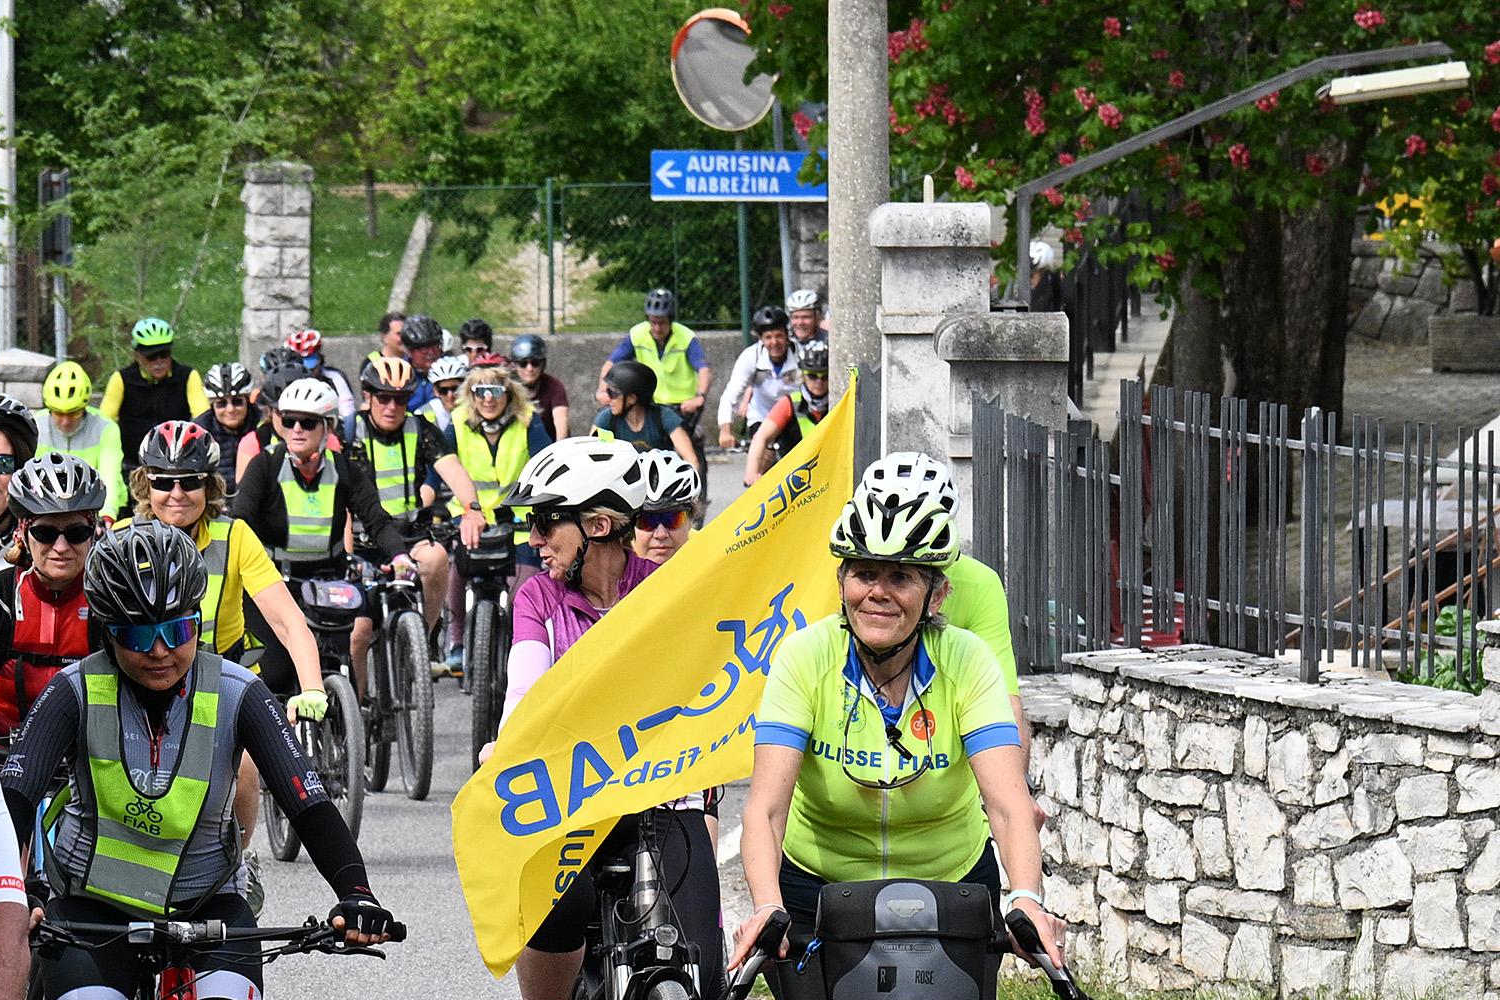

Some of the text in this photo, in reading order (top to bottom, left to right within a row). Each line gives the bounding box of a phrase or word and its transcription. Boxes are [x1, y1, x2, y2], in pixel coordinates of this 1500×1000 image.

[686, 155, 791, 173] AURISINA
[685, 174, 780, 194] NABREŽINA
[29, 685, 56, 715] Volanti
[264, 698, 302, 759] Leoni Volanti
[810, 738, 950, 771] ULISSE FIAB
[123, 815, 161, 836] FIAB
[914, 969, 935, 985] ROSE
